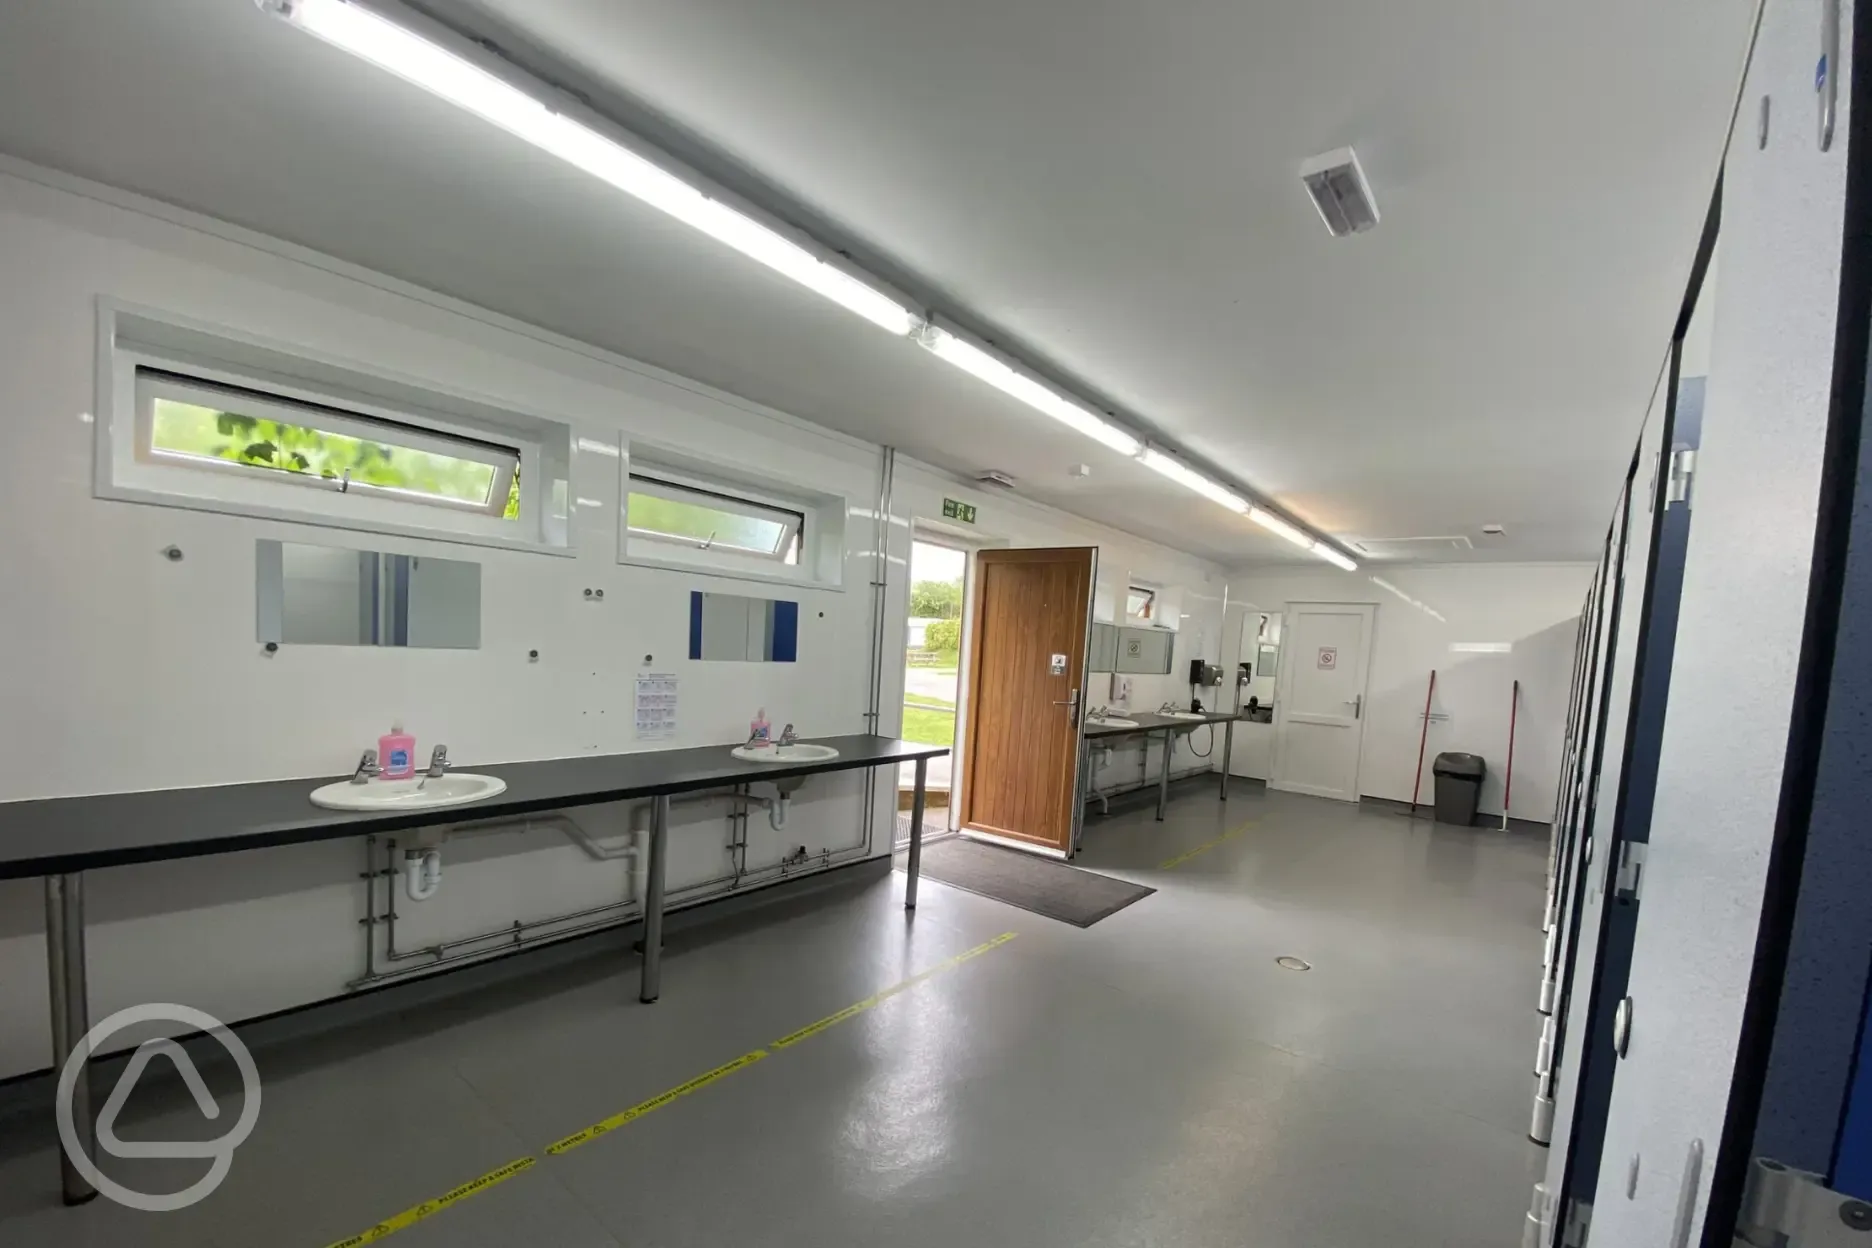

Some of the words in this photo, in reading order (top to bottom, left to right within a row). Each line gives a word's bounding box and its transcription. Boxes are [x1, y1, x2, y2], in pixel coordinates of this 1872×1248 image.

[438, 1187, 467, 1204] PLEASE
[469, 1178, 488, 1190] KEEP
[495, 1167, 512, 1178] SAFE
